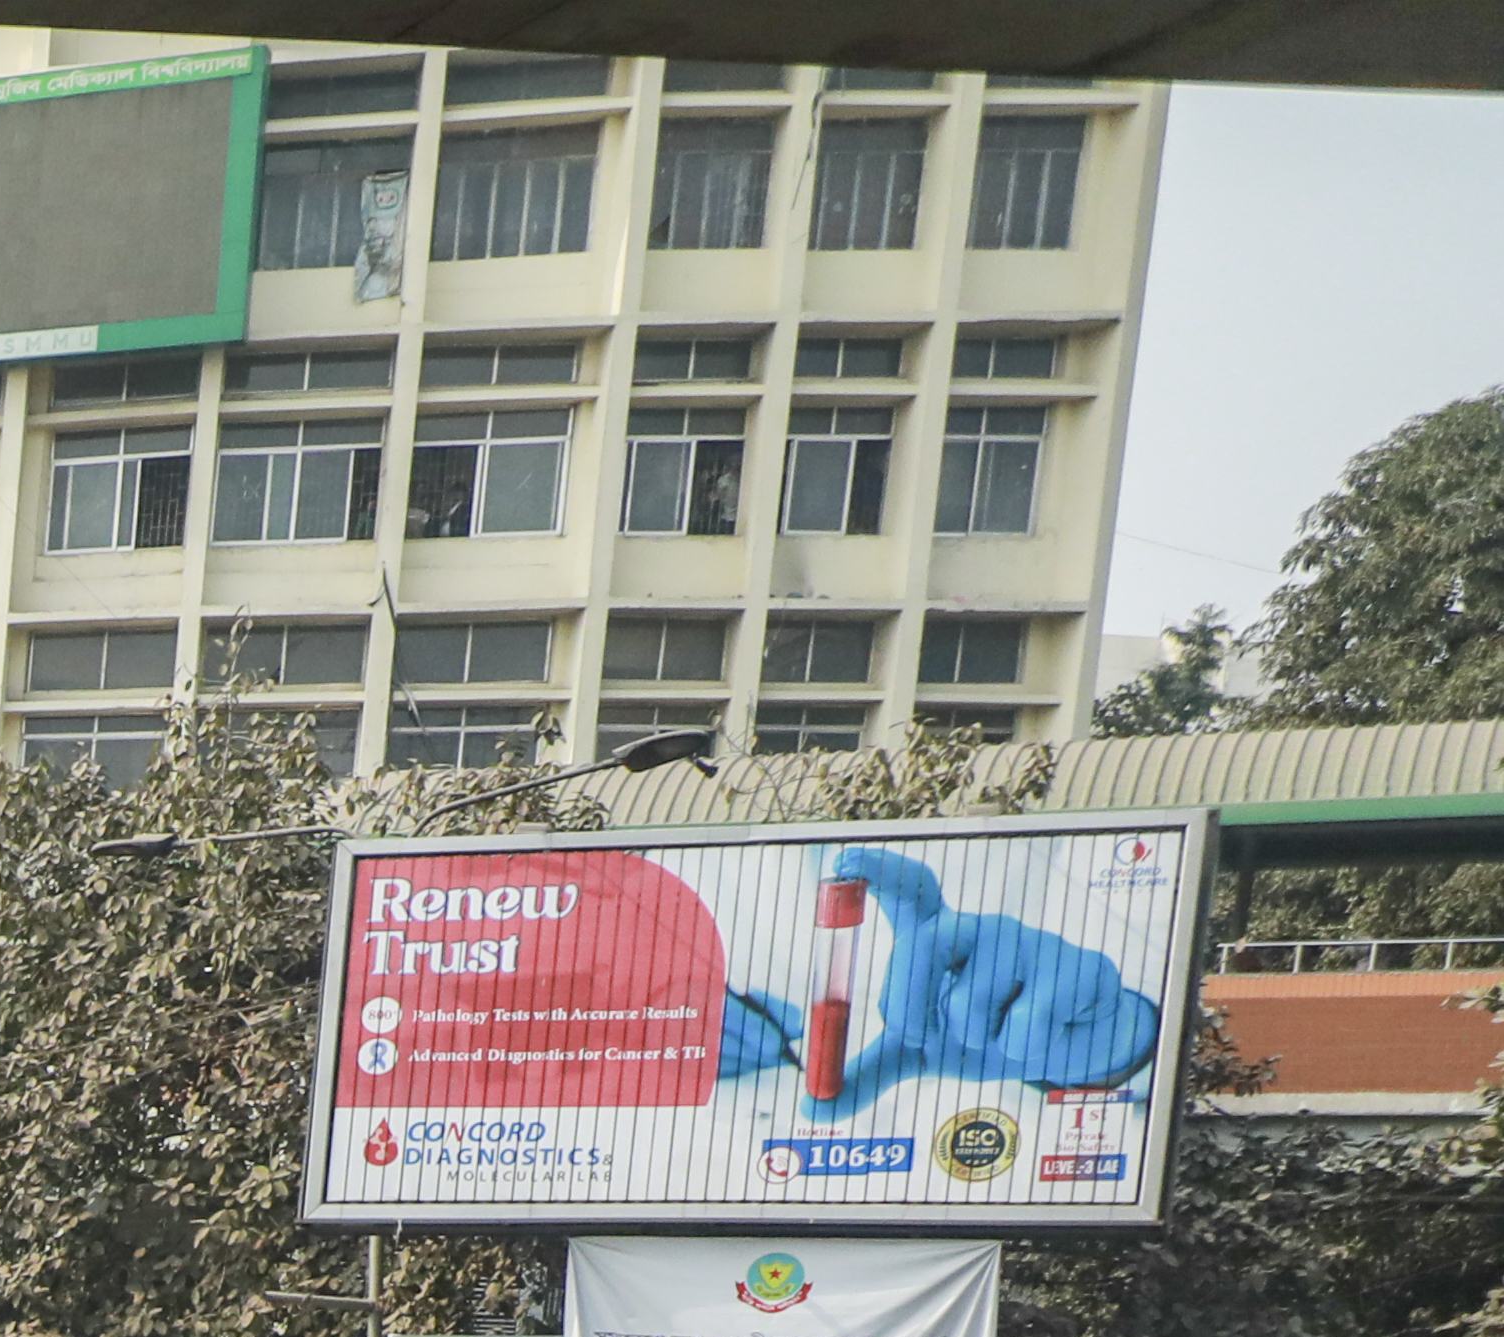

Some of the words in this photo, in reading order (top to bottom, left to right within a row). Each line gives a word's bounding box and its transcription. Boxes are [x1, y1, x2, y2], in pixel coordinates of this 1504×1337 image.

[366, 876, 581, 924] Renew
[362, 928, 521, 976] Trust
[412, 1008, 490, 1025] Pathology
[492, 1008, 531, 1022] Tests
[534, 1007, 568, 1021] with
[570, 1006, 639, 1021] Accurate
[642, 1005, 698, 1021] Results
[408, 1047, 482, 1062] Advanced
[487, 1047, 576, 1064] Diagnostics
[579, 1046, 601, 1061] for
[605, 1047, 661, 1061] Cancer
[664, 1046, 678, 1060] &
[407, 1120, 547, 1143] CONCORD
[958, 1128, 999, 1147] ISO
[807, 1144, 907, 1169] 10649
[446, 1170, 567, 1182] MOLECULAR
[577, 1169, 613, 1182] LAB
